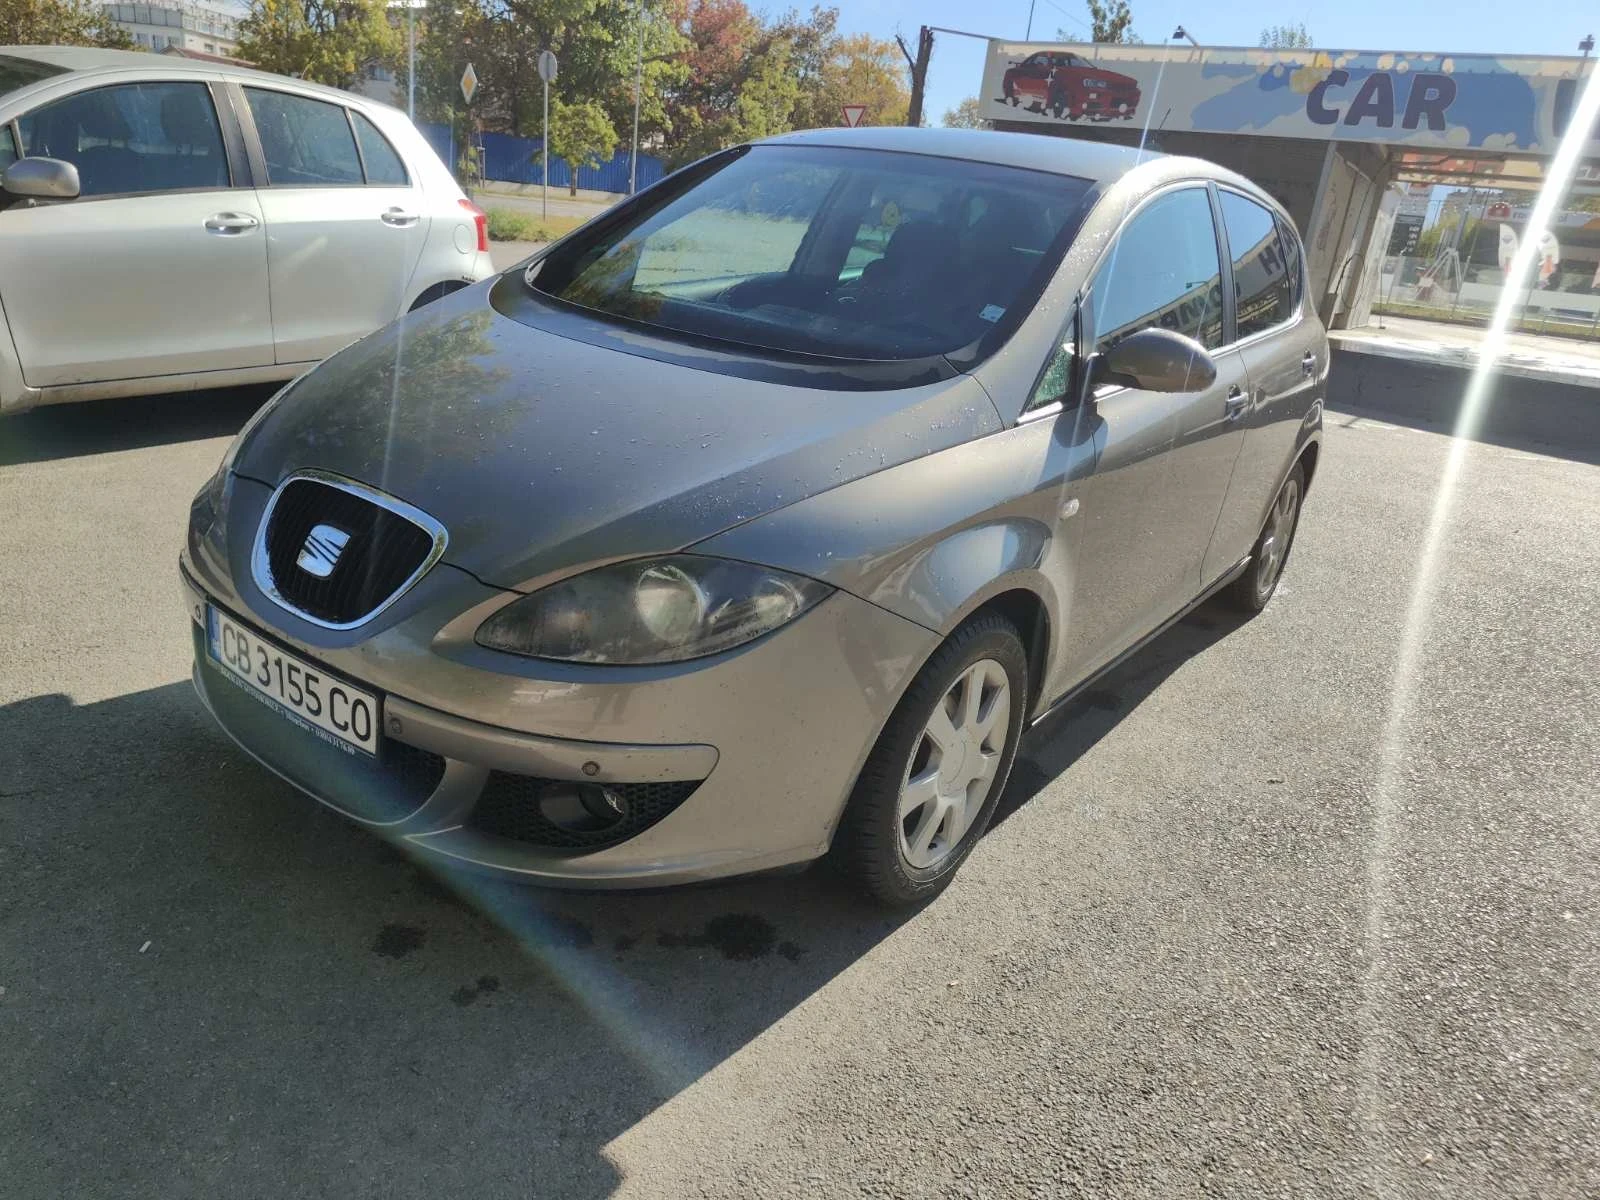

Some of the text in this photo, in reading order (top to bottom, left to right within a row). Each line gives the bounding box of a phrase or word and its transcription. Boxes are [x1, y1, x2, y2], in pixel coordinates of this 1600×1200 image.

[1306, 70, 1457, 131] CAR
[223, 623, 250, 674] CB
[256, 644, 322, 717] 3155
[329, 686, 371, 742] CO
